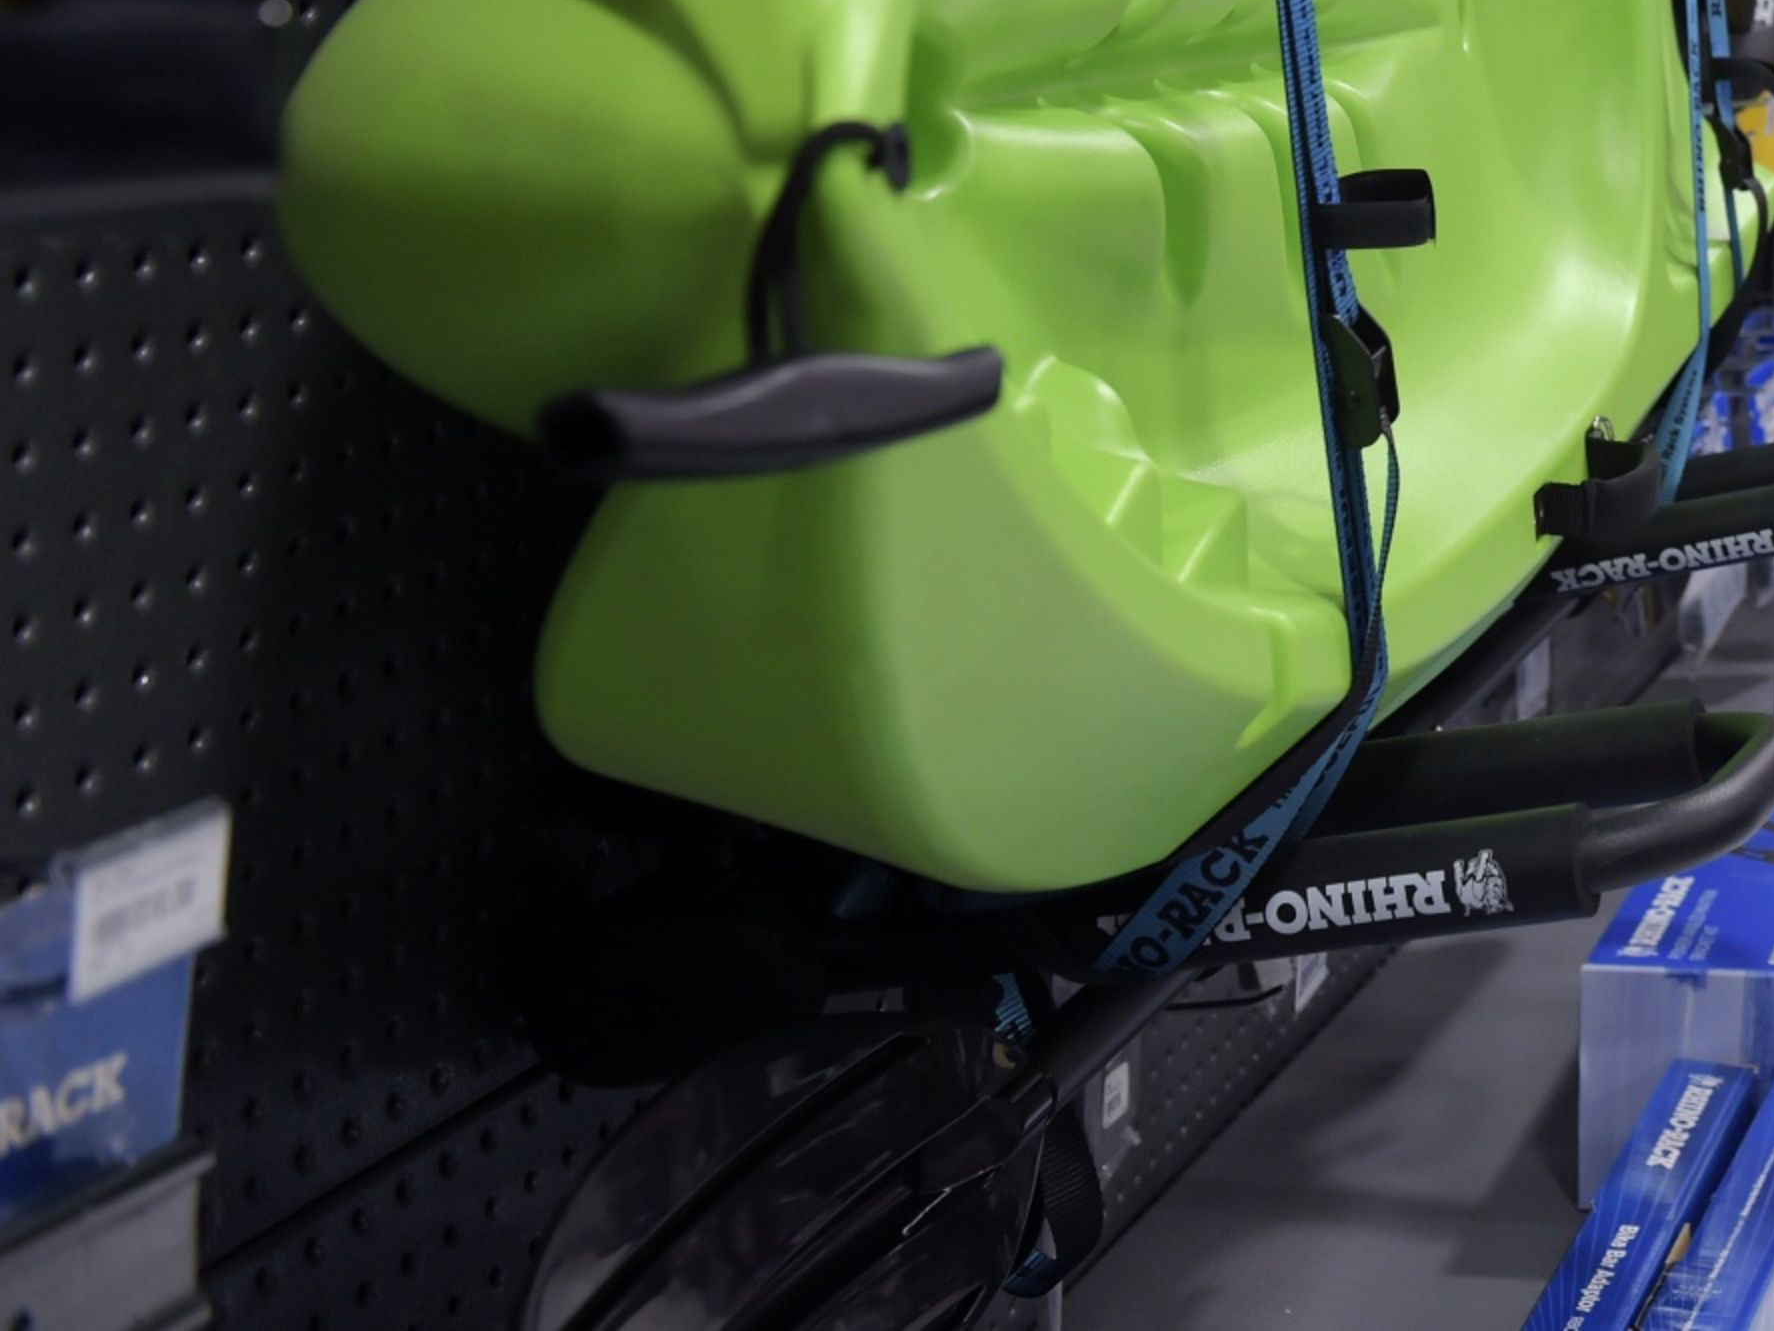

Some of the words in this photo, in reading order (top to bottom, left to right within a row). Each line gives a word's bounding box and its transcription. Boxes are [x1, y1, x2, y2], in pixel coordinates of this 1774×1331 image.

[1097, 869, 1451, 945] RHINO-R
[1646, 1085, 1713, 1171] RHINO-RACK
[1611, 1224, 1641, 1248] Bike
[1600, 1249, 1627, 1269] Bar
[1576, 1269, 1616, 1313] Adaptor
